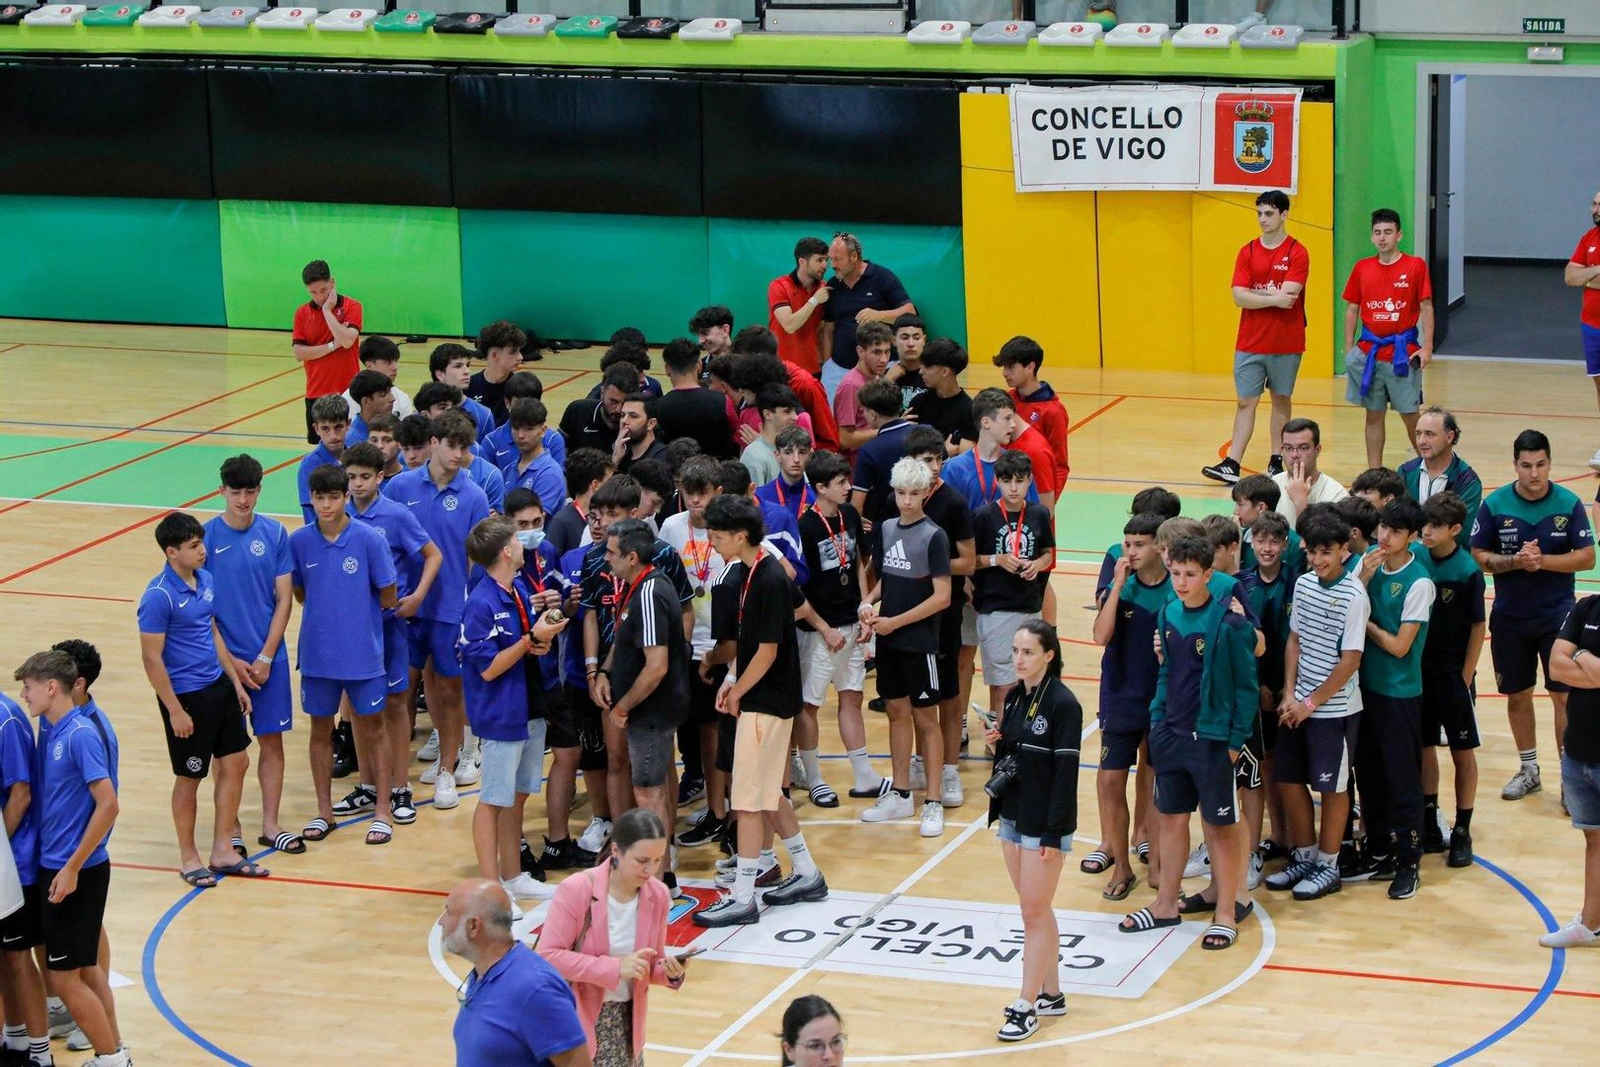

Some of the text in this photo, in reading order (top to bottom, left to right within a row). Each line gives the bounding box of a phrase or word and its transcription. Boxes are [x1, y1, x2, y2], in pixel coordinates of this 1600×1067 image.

[1526, 20, 1561, 31] SALIDA
[1031, 106, 1183, 131] CONCELLO
[1052, 137, 1166, 160] DE VIGO
[883, 556, 911, 570] adidas
[833, 915, 974, 939] VIGO
